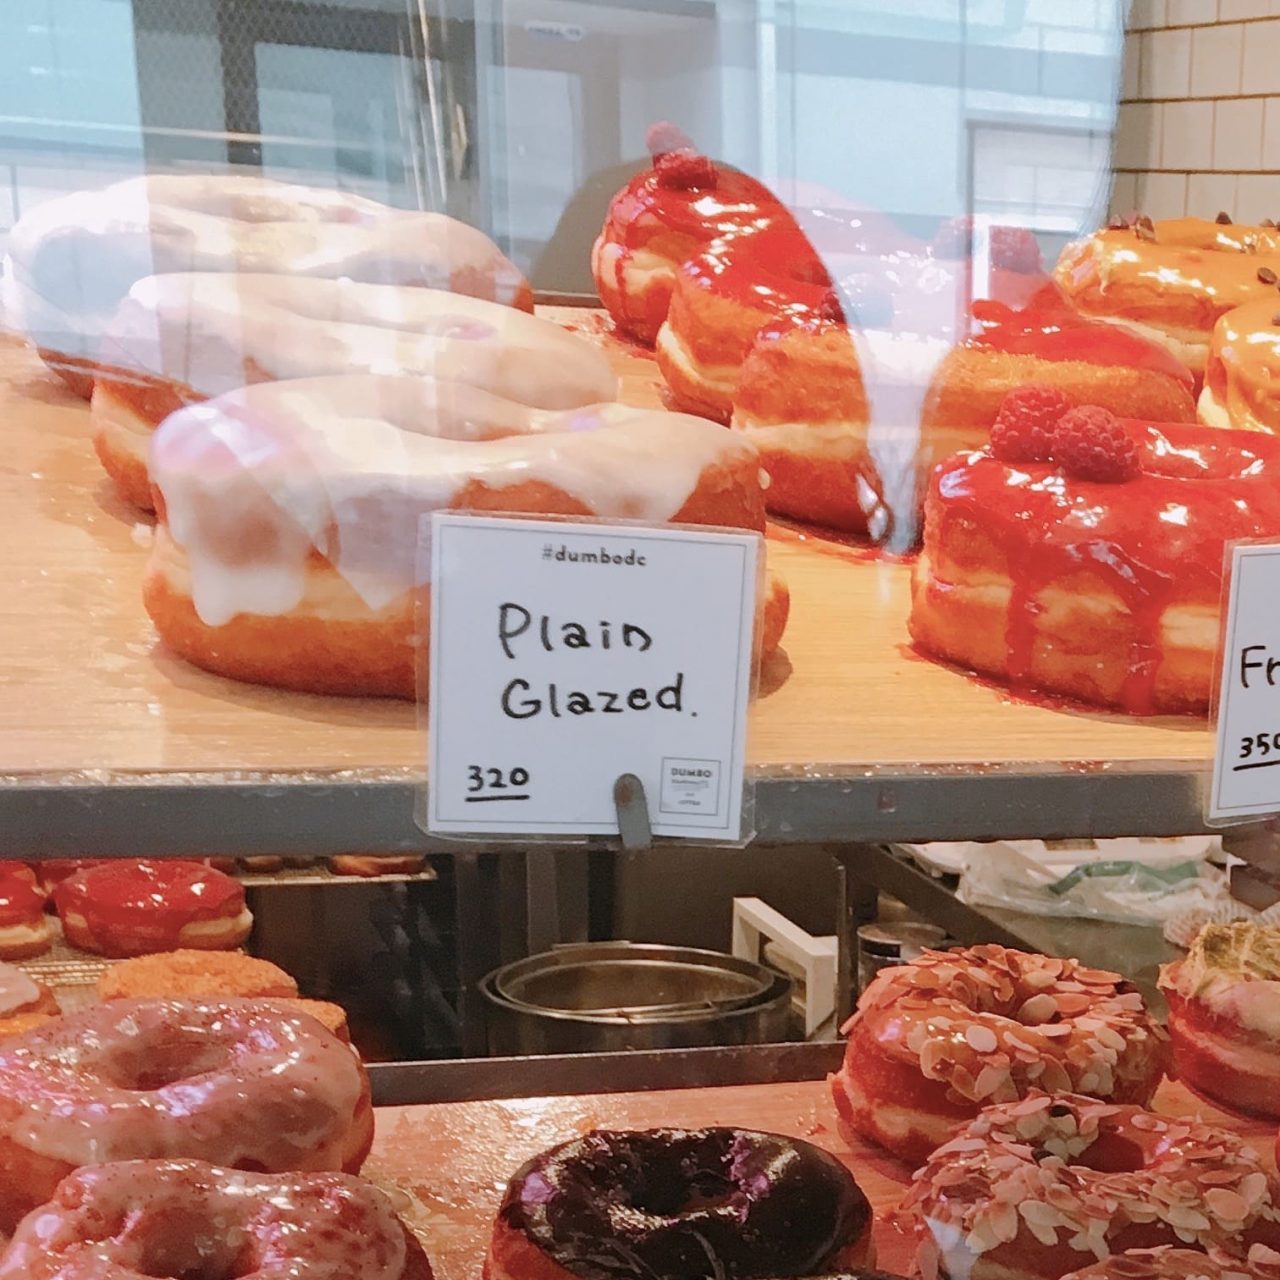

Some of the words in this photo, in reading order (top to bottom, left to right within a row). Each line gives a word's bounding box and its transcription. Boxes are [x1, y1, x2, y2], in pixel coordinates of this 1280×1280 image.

[542, 544, 647, 567] #dumbodc
[498, 602, 652, 659] Plain
[501, 673, 698, 719] Glazed.
[467, 765, 530, 791] 320
